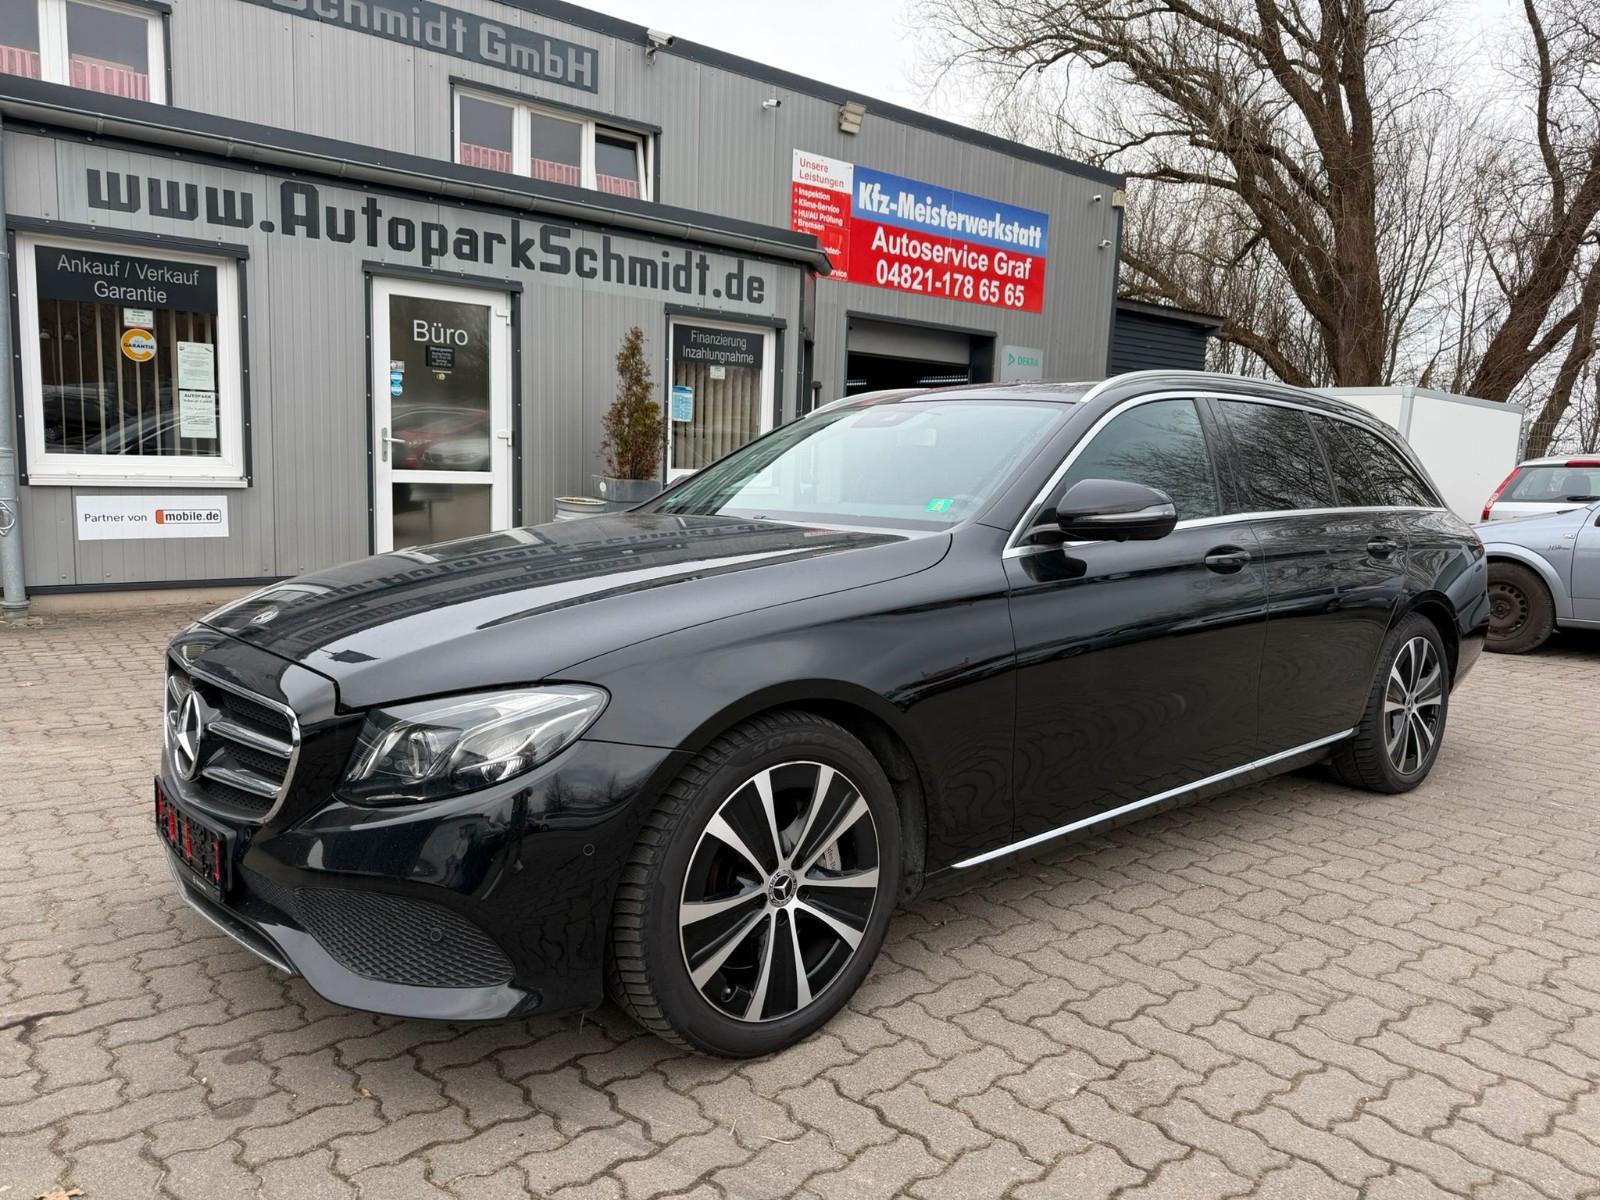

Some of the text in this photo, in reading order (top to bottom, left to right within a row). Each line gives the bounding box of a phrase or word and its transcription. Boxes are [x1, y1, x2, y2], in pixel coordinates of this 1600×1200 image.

[478, 22, 592, 87] GmbH
[800, 157, 829, 173] Unsere
[799, 170, 844, 189] Leistungen
[858, 181, 1042, 249] Kfz-Meisterwerkstatt
[86, 168, 765, 304] www.AutoparkSchmidt.de
[871, 226, 1033, 280] Autoservice Graf
[57, 254, 200, 286] Ankauf / Verkauf
[94, 280, 168, 304] Garantie
[876, 258, 1025, 308] 04821-178 65 65
[413, 319, 468, 346] Büro
[691, 329, 747, 352] Finanzierung
[682, 345, 754, 364] Inzahlungnahme
[84, 513, 148, 523] Partner von
[165, 511, 219, 521] mobile.de
